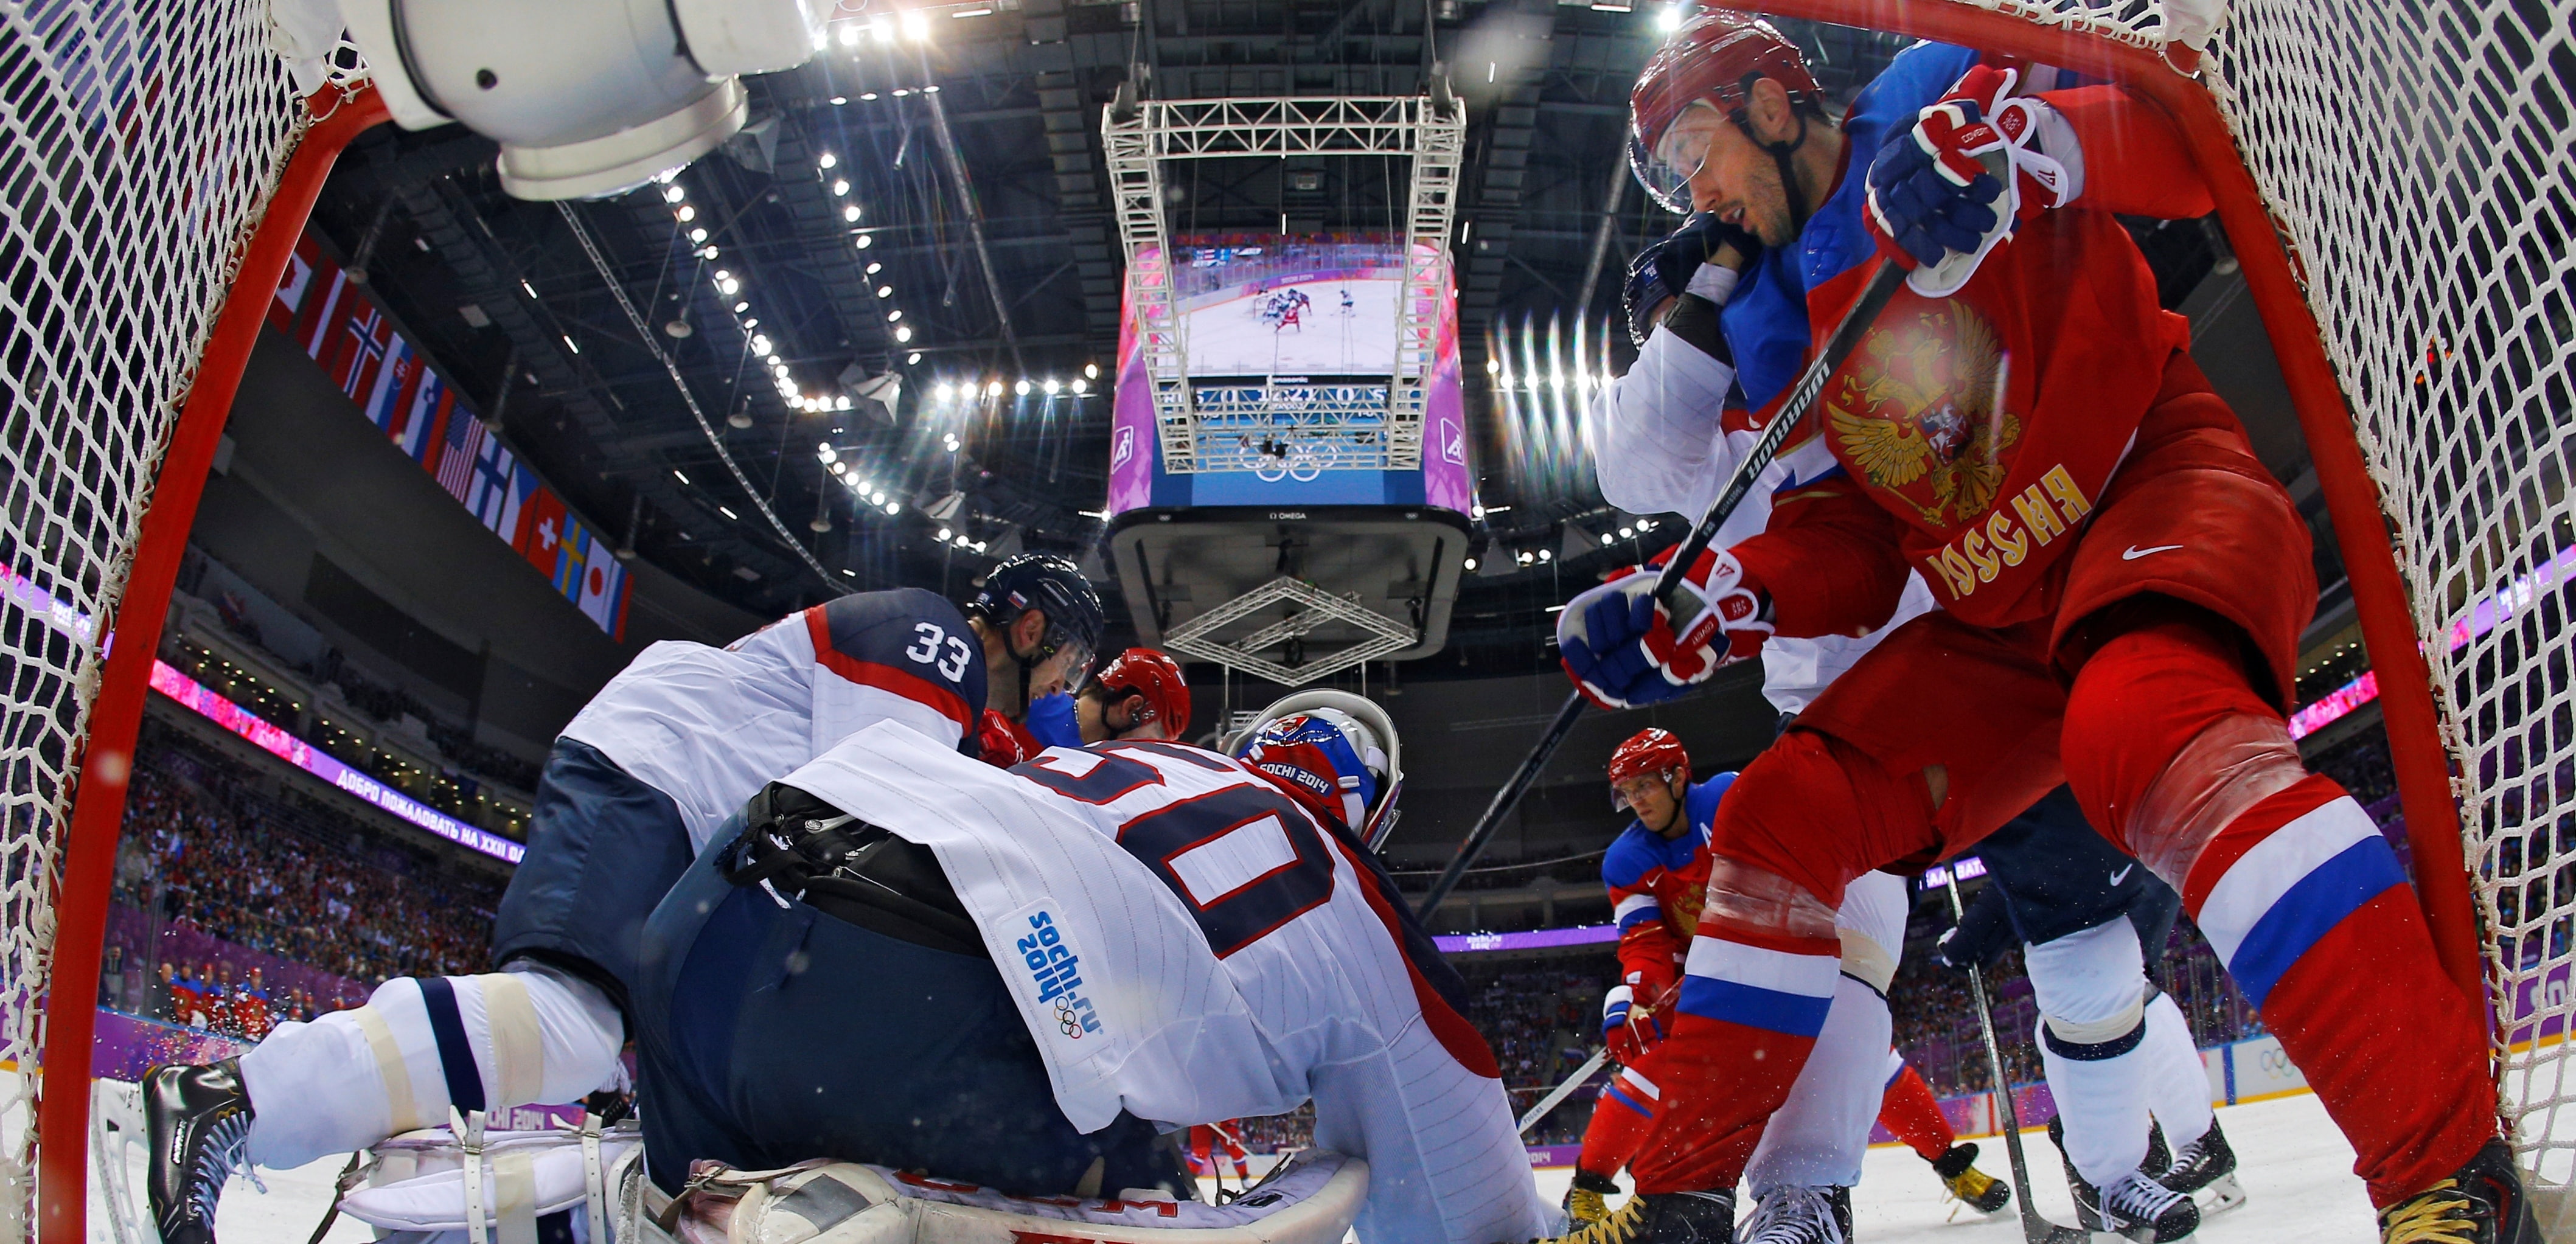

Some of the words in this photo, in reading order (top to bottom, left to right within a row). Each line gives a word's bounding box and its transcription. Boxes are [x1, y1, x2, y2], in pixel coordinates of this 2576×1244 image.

[2038, 170, 2056, 186] 17
[1747, 362, 1831, 480] WARRIOR
[1716, 562, 1735, 578] 17
[905, 621, 972, 683] 33
[1259, 763, 1295, 778] SOCHI
[1296, 770, 1329, 794] 2014
[336, 768, 380, 802] ДОБРО
[381, 790, 459, 840] ПОЖАЛОВАТЬ
[461, 827, 479, 848] НА
[1017, 933, 1065, 1004] 2014
[1028, 911, 1101, 1034] sochi.ru
[512, 1108, 545, 1130] 2014
[1528, 1152, 1551, 1164] 014
